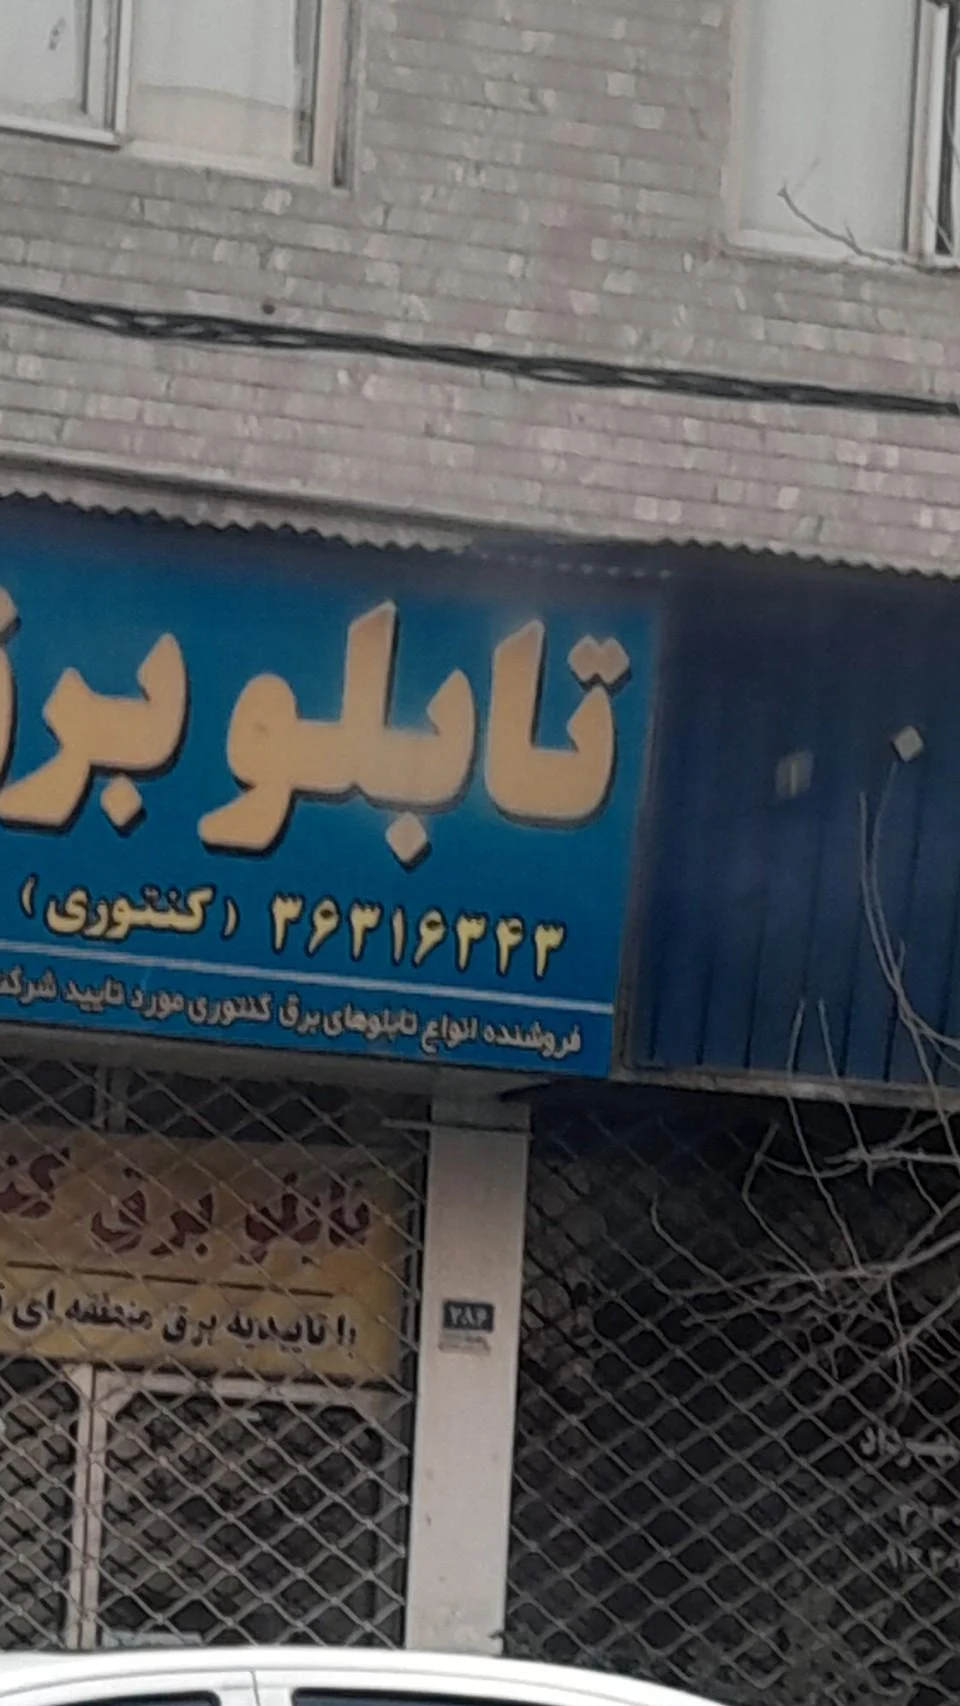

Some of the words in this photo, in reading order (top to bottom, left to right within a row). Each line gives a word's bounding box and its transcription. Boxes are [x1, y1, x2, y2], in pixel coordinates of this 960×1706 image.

[197, 599, 632, 872] تابلو
[270, 892, 567, 980] ۳۶۳۱۶۳۴۳
[63, 973, 125, 1014] تایید
[130, 985, 186, 1020] مورد
[187, 989, 274, 1027] کنتوری
[277, 991, 322, 1036] برق
[323, 1002, 419, 1043] تابلوهای
[420, 1013, 479, 1053] انواع
[482, 1020, 583, 1059] فروشنده
[89, 1164, 216, 1258] برق
